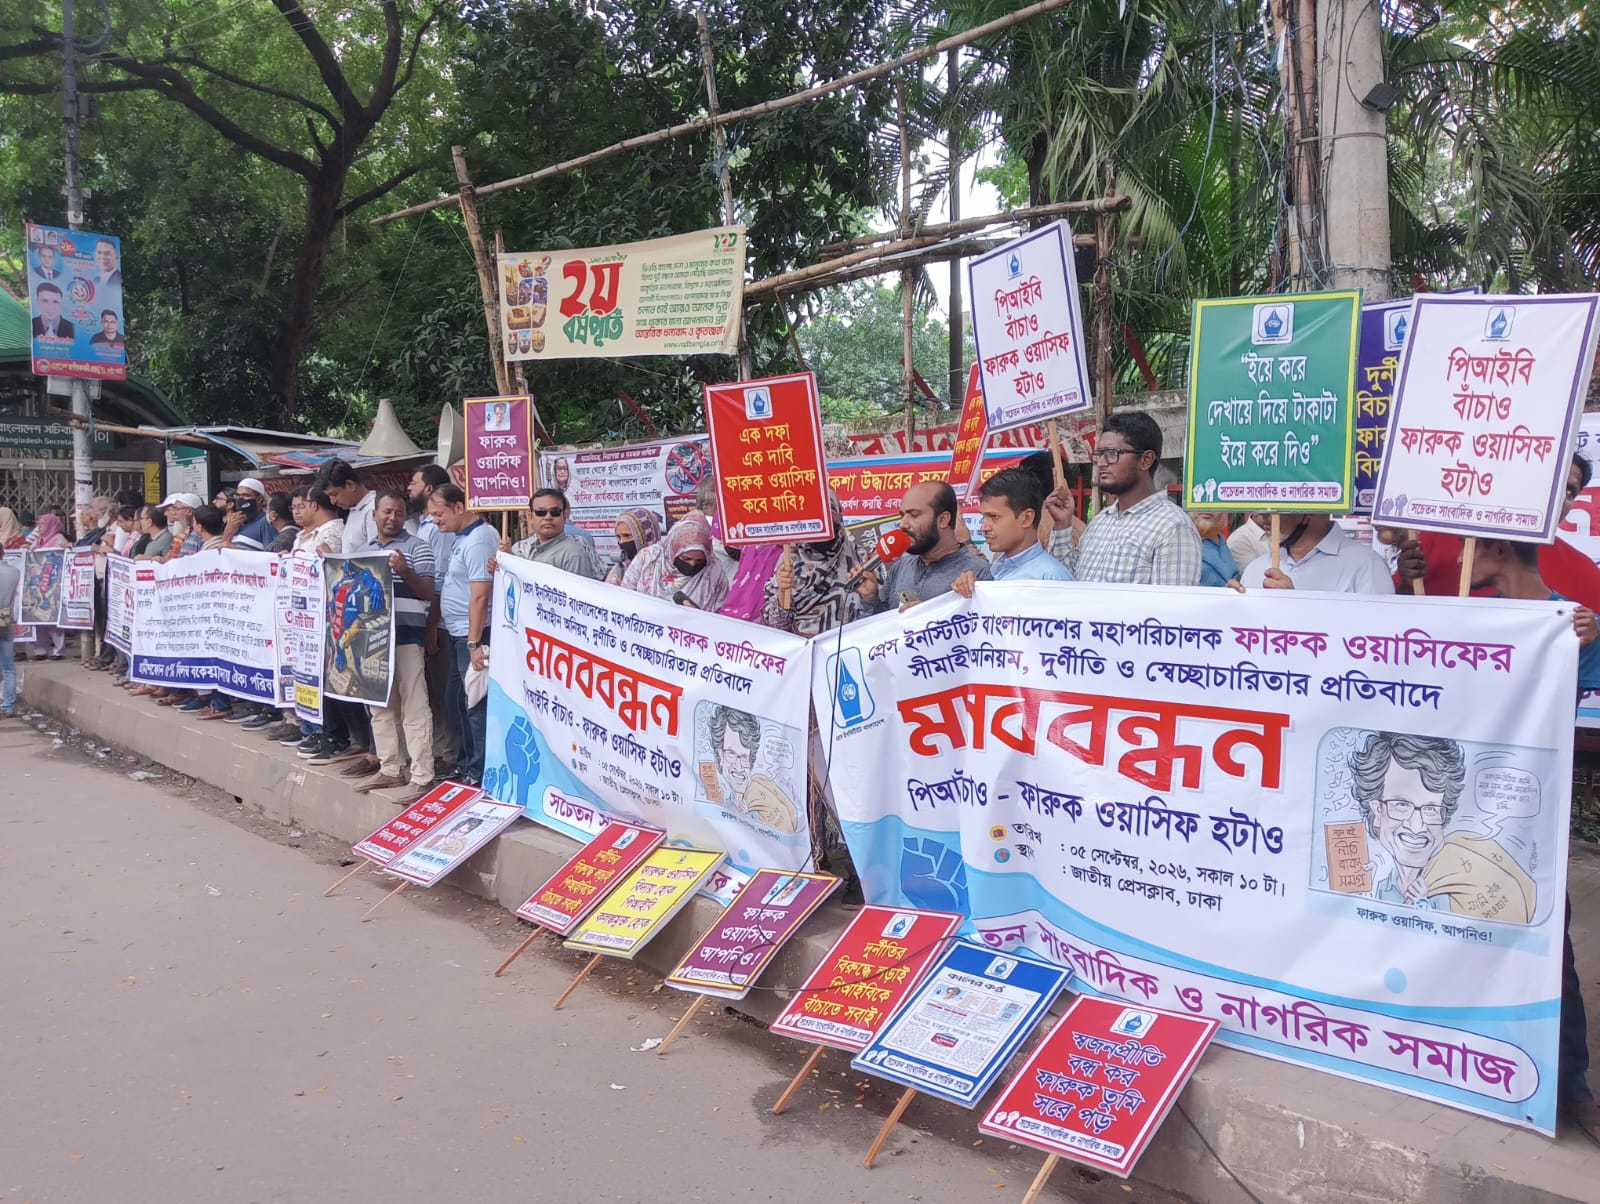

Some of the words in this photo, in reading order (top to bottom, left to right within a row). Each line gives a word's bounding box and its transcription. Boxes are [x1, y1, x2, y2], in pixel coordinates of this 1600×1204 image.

[994, 275, 1043, 317] পিআইবি
[1004, 312, 1039, 342] বাঁচাও
[983, 348, 1020, 377] ফারুক
[1023, 330, 1070, 364] ওয়াসিফ
[1278, 355, 1308, 382] করে
[1446, 347, 1537, 387] পিআইবি
[1013, 371, 1045, 399] হটাও
[1207, 396, 1254, 427] দেখায়ে
[1257, 389, 1289, 425] দিয়ে
[1291, 388, 1338, 425] টাকাটা
[1356, 391, 1393, 419] বিচা
[1453, 384, 1512, 422] বাঁচাও
[478, 434, 517, 449] ফারুক
[739, 425, 761, 445] এক
[764, 422, 790, 442] দফা
[1219, 432, 1247, 470] ইয়ে
[1250, 440, 1279, 467] করে
[1400, 425, 1464, 457] ফারুক
[1472, 424, 1556, 463] ওয়াসিফ
[476, 451, 521, 470] ওয়াসিফ
[742, 449, 764, 468] এক
[767, 442, 794, 466] দাবি
[472, 472, 526, 491] আপনিও!
[724, 474, 764, 493] ফারুক
[768, 465, 816, 489] ওয়াসিফ
[860, 468, 915, 492] উদ্ধারের
[1220, 486, 1244, 498] সচেতন
[1246, 483, 1278, 498] সাংবাদিক
[1281, 487, 1287, 498] ও
[1289, 483, 1316, 498] নাগরিক
[1317, 486, 1339, 499] সমাজ
[1440, 459, 1494, 499] হটাও
[741, 496, 768, 514] কবে
[861, 495, 882, 510] করছি
[1411, 502, 1437, 517] সচেতন
[1439, 503, 1473, 521] সাংবাদিক
[1476, 511, 1482, 521] ও
[1485, 508, 1513, 525] নাগরিক
[1515, 513, 1539, 528] সমাজ
[536, 603, 562, 629] সীমাহীন
[620, 640, 628, 653] ও
[630, 643, 698, 677] স্বেচ্ছাচারিতার
[700, 663, 753, 695] প্রতিবাদে
[569, 596, 609, 623] বাংলাদেশের
[611, 610, 664, 640] মহাপরিচালক
[667, 625, 709, 653] ফারুক
[715, 640, 787, 676] ওয়াসিফের
[868, 638, 899, 661] প্রেস
[981, 613, 1081, 642] বাংলাদেশের
[1090, 617, 1222, 650] মহাপরিচালক
[1231, 626, 1328, 658] ফারুক
[1342, 628, 1515, 673] ওয়াসিফের
[525, 626, 684, 737] মানববন্ধন
[1039, 646, 1107, 679] দুর্ণীতি
[1117, 660, 1134, 679] ও
[1146, 660, 1311, 697] স্বেচ্ছাচারিতার
[1320, 669, 1444, 710] প্রতিবাদে
[552, 695, 574, 728] বাঁচাও
[582, 716, 608, 745] ফারুক
[611, 733, 647, 766] ওয়াসিফ
[650, 745, 682, 778] হটাও
[550, 792, 595, 829] সচেতন
[1016, 780, 1086, 824] ফারুক
[1096, 795, 1201, 843] ওয়াসিফ
[1209, 807, 1284, 855] হটাও
[1070, 845, 1086, 859] ০৫
[1091, 848, 1143, 874] সেপ্টেম্বর,
[1149, 859, 1191, 883] ২০২৬,
[1196, 867, 1234, 887] সকাল
[1239, 875, 1258, 890] ১০
[1070, 865, 1112, 889] জাতীয়
[1118, 878, 1180, 907] প্রেসক্লাব,
[1186, 890, 1223, 911] ঢাকা
[743, 907, 789, 923] ফারুক
[1357, 905, 1388, 923] ফারুক
[1391, 913, 1438, 935] ওয়াসিফ,
[1441, 922, 1494, 943] আপনিও!
[721, 924, 776, 944] ওয়াসিফ
[862, 939, 908, 961] দুর্নীতির
[832, 954, 875, 981] বিরুদ্ধে
[803, 992, 844, 1017] বাঁচাতে
[824, 976, 893, 1004] পিআইবিকে
[1039, 921, 1159, 1000] সাংবাদিক
[1173, 984, 1203, 1013] ও
[1216, 992, 1371, 1053] নাগরিক
[1383, 1030, 1520, 1094] সমাজ
[1072, 1032, 1166, 1066] স্বজনপ্রীতি
[1067, 1054, 1102, 1078] বন্ধ
[1103, 1063, 1140, 1087] কর
[1035, 1068, 1099, 1100] ফারুক
[1099, 1086, 1145, 1115] তুমি
[1033, 1093, 1075, 1121] সরে
[1079, 1108, 1117, 1134] পড়
[1018, 1117, 1040, 1133] সচেতন
[1040, 1125, 1069, 1141] সাংবাদিক
[1076, 1136, 1101, 1151] নাগরিক
[1102, 1144, 1122, 1158] সমাজ
